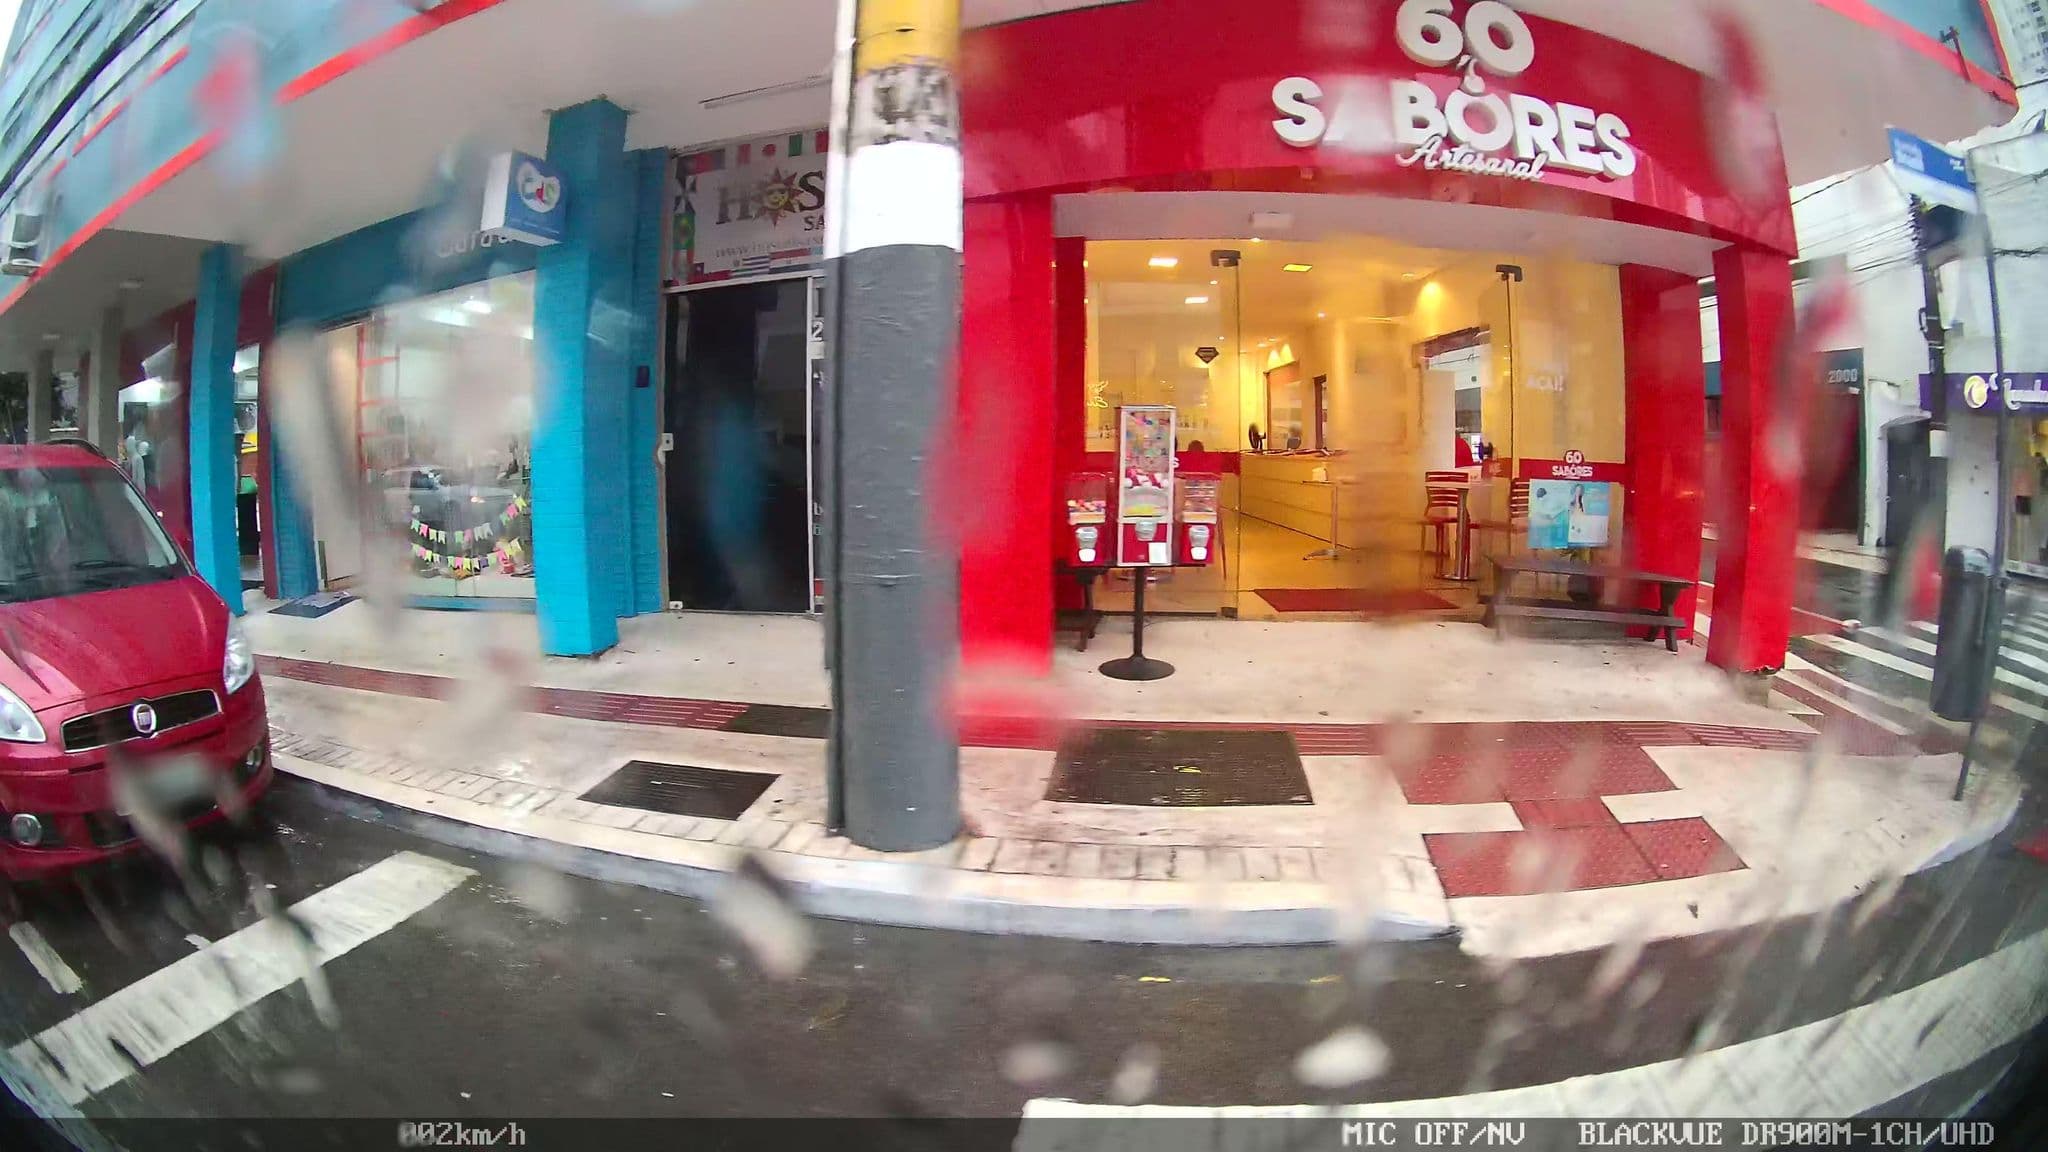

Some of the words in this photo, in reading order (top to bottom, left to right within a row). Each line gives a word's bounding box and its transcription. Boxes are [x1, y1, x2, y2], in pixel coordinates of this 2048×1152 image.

[1396, 0, 1535, 76] 60
[1395, 136, 1549, 180] Artesanal
[1565, 451, 1582, 464] 60
